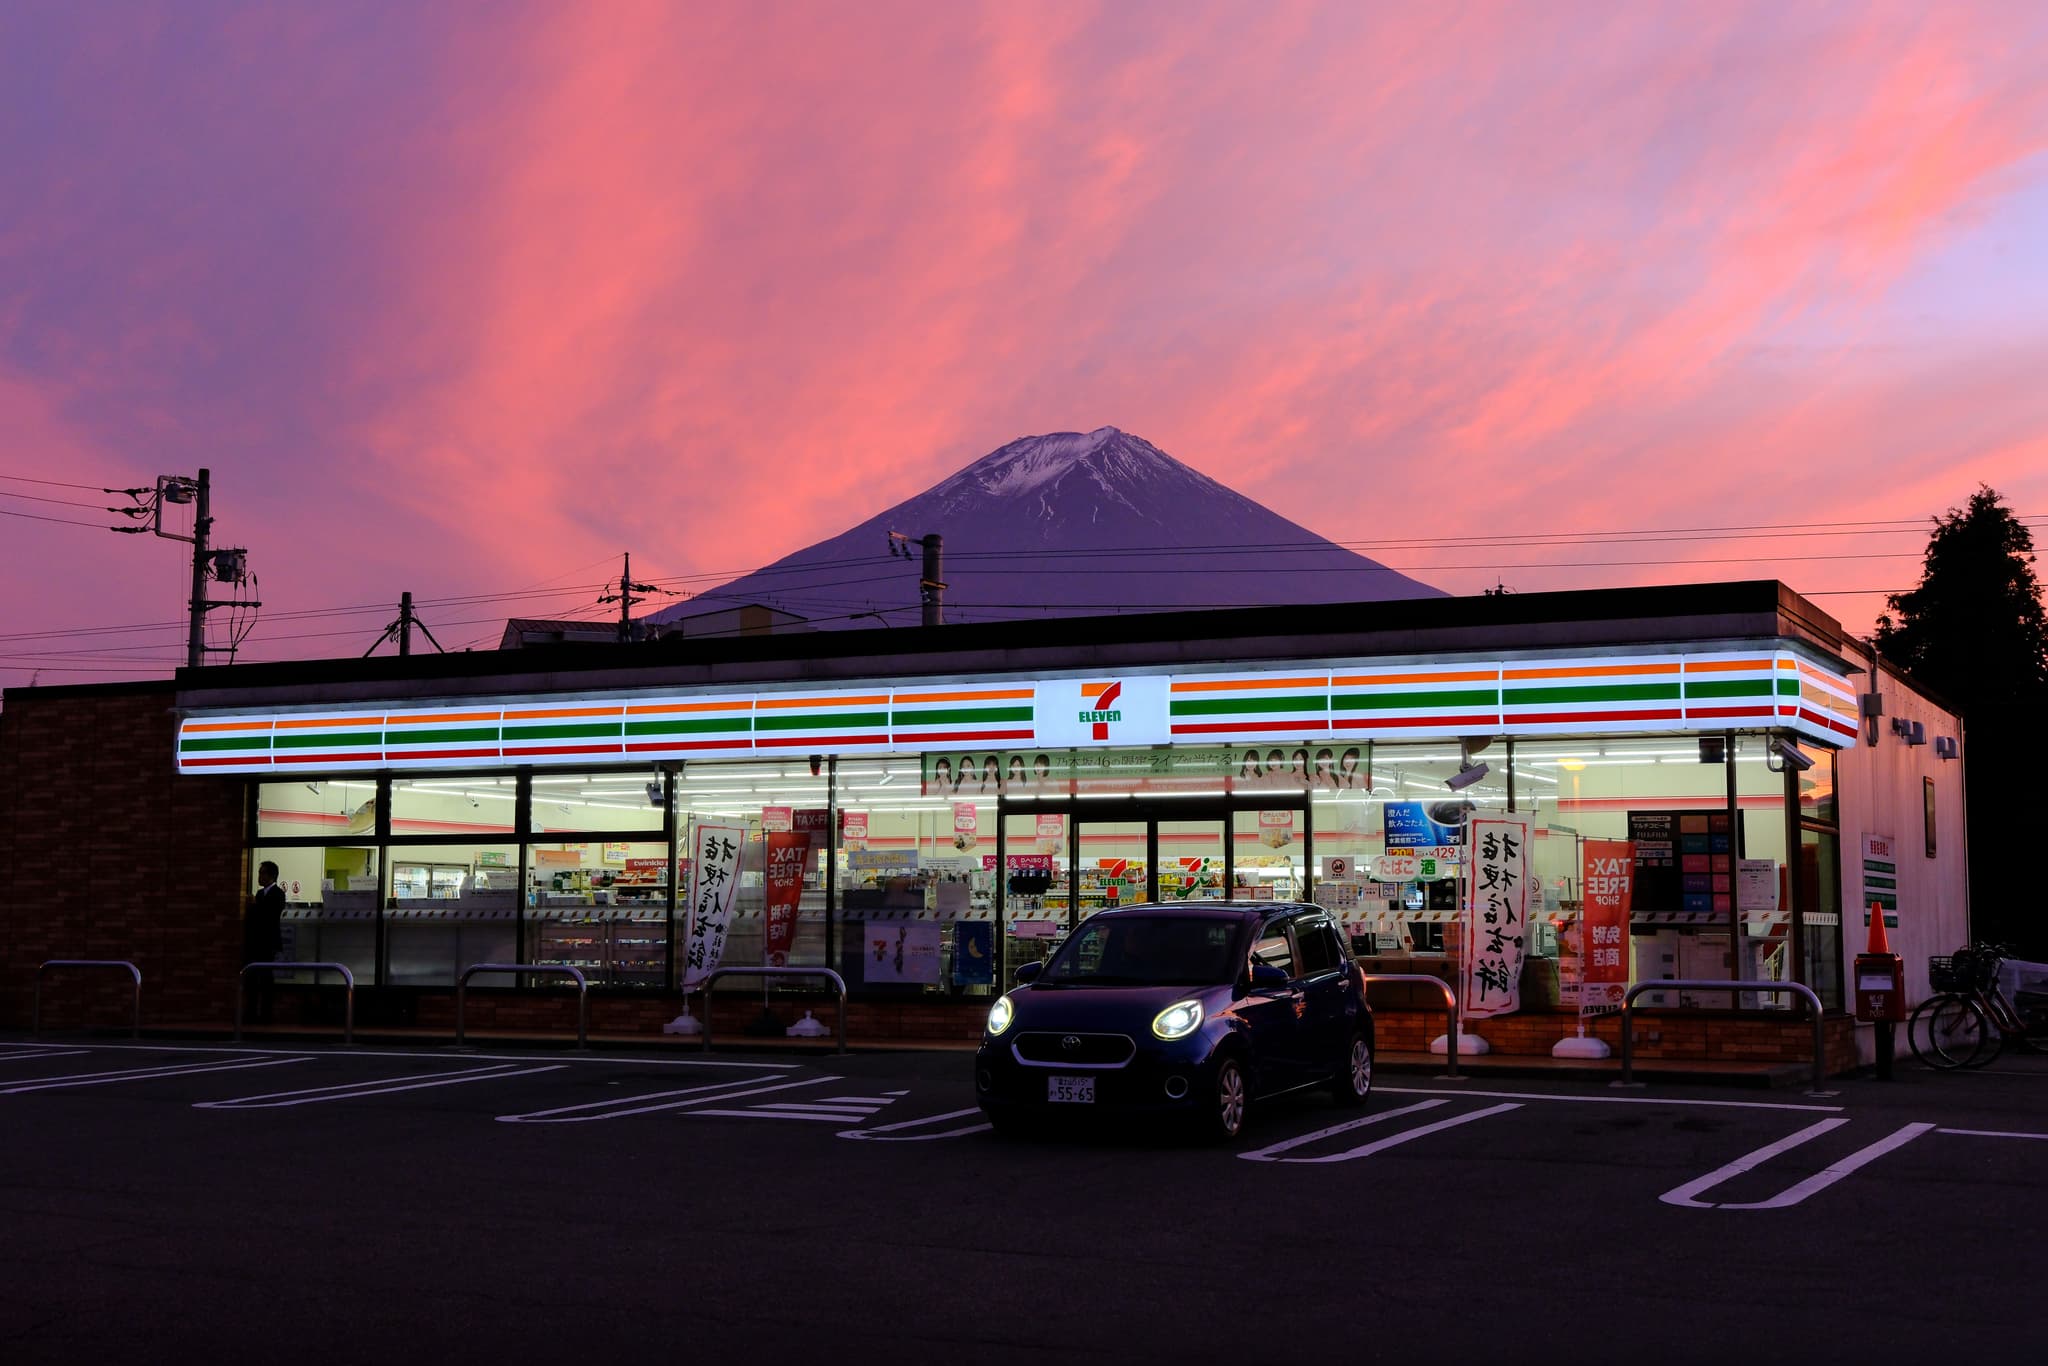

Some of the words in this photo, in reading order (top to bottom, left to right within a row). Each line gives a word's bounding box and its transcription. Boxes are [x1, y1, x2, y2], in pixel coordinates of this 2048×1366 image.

[1079, 710, 1122, 723] ELEVEN
[1081, 680, 1122, 741] 7
[1387, 808, 1410, 818] 澄んだ
[796, 814, 843, 826] TAX-FE
[1379, 859, 1414, 875] たばこ
[1420, 859, 1436, 875] 酒
[1099, 878, 1127, 887] ELEVEN
